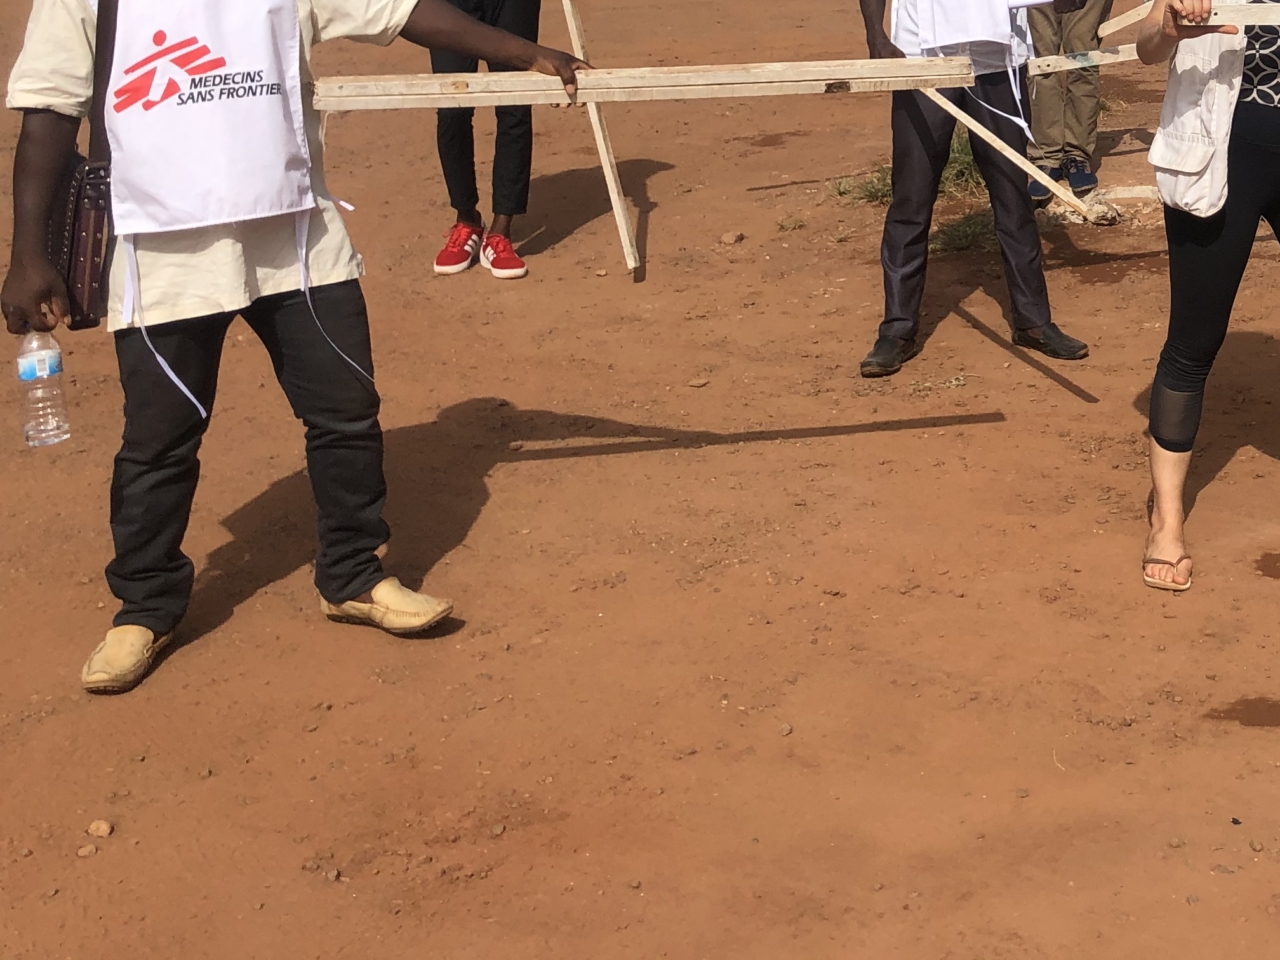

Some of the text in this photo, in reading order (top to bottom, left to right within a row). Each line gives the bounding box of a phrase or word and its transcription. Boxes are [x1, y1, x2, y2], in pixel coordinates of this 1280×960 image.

[189, 70, 264, 90] MEDECINS
[176, 82, 282, 106] SANS FRONTIER
